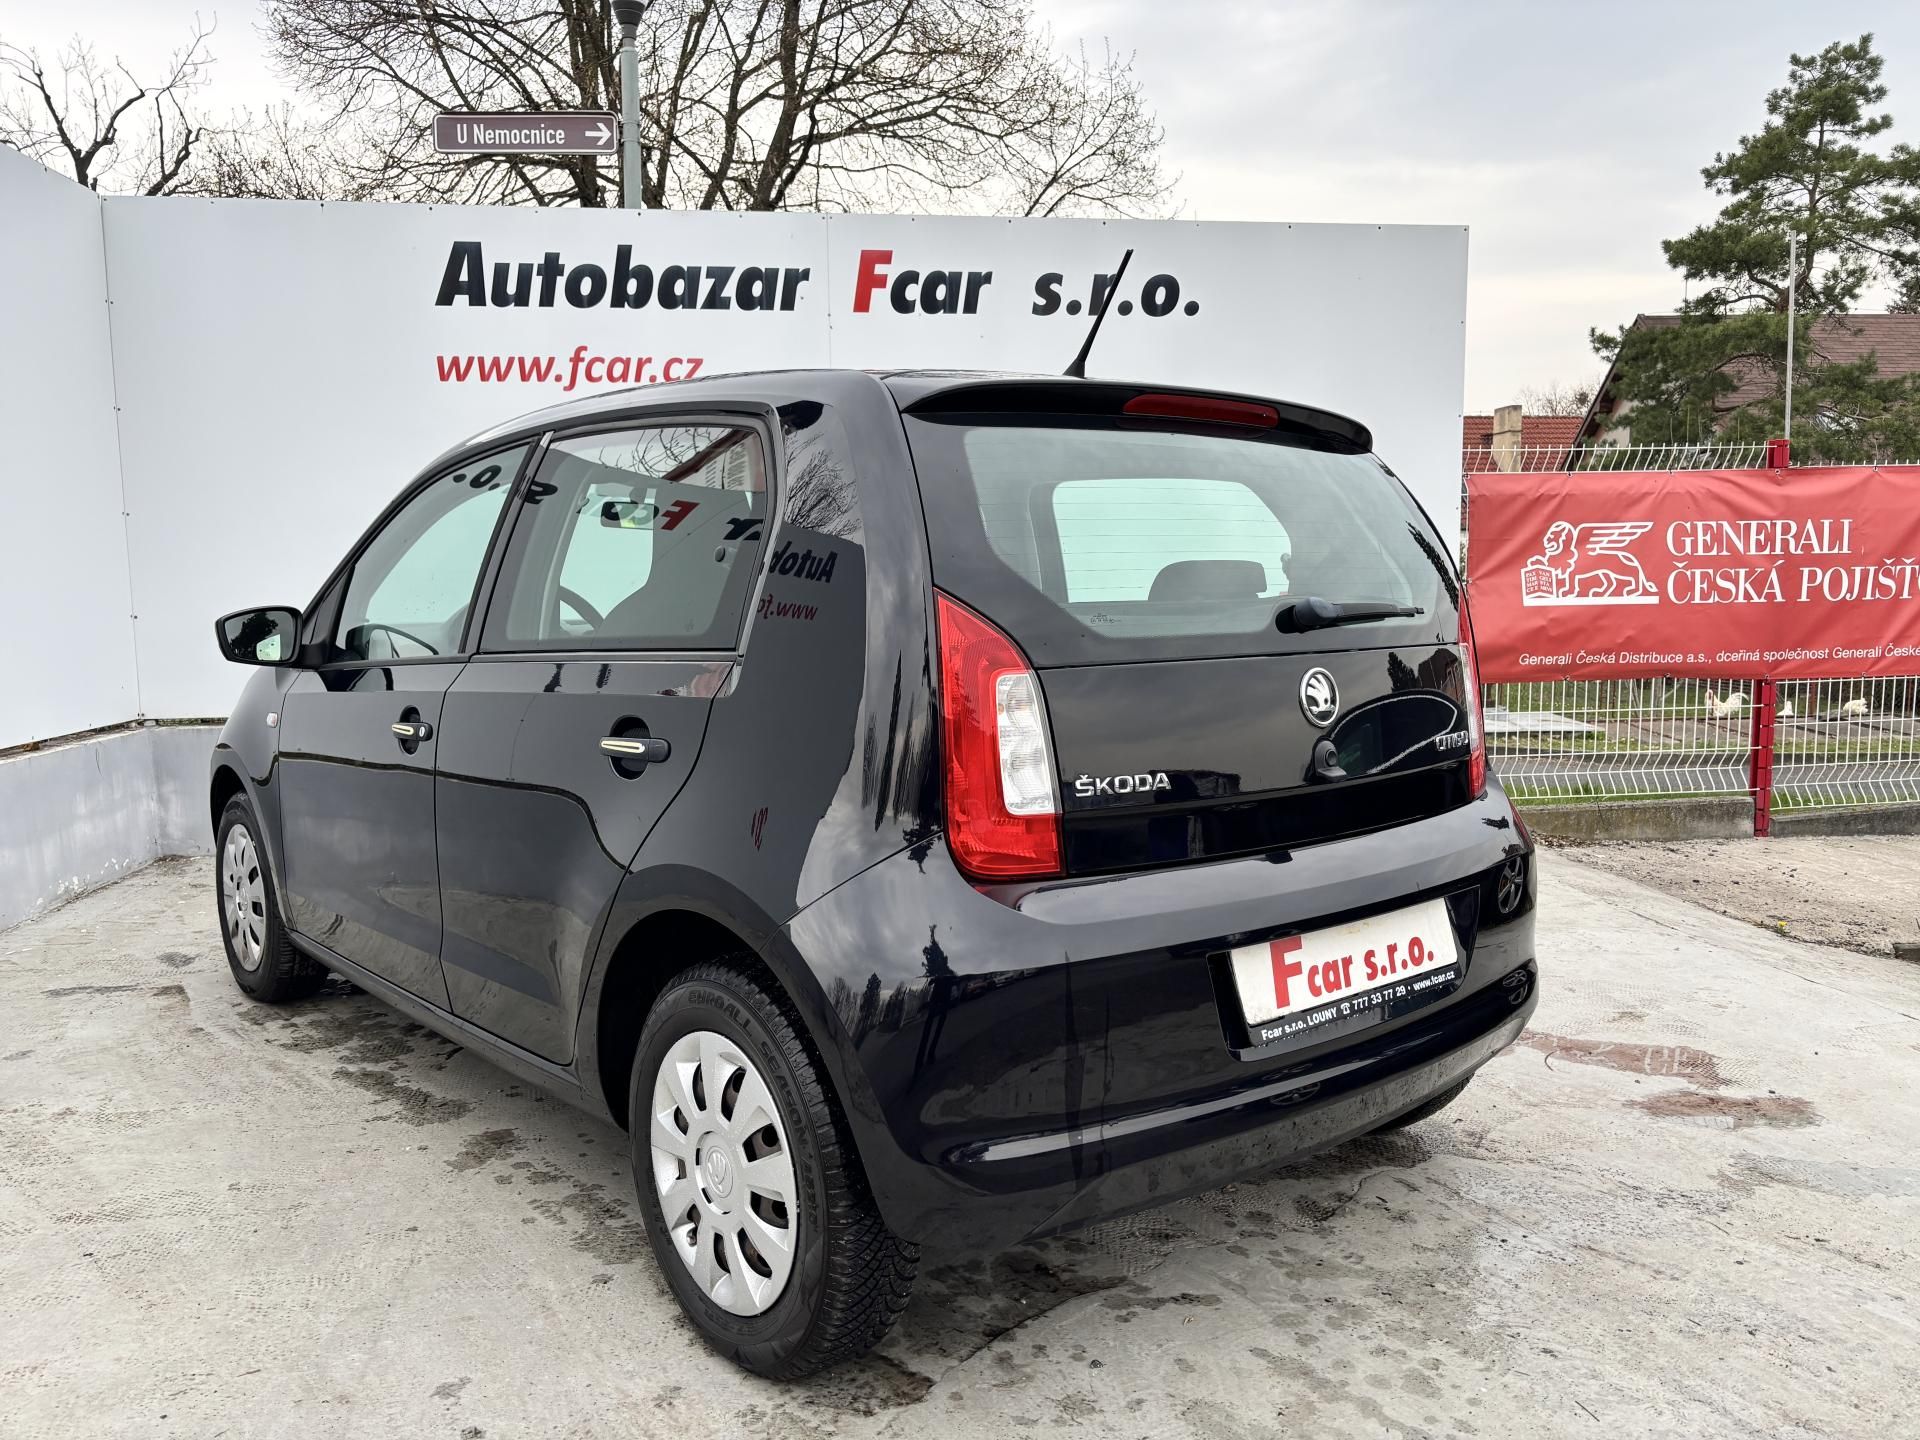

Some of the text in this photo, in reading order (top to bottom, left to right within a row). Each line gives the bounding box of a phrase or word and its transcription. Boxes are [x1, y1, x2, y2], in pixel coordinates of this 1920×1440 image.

[457, 123, 565, 145] U Nemocnice
[435, 241, 1200, 317] Autobazar Fcar s.r.o.
[436, 345, 704, 391] www.fcar.cz
[1666, 518, 1853, 557] GENERALI
[1667, 558, 1920, 604] ČESKÁ POJIŠŤ
[1519, 653, 1572, 665] Generali
[1576, 650, 1616, 664] Česká
[1619, 652, 1683, 664] Distribuce
[1687, 653, 1712, 664] a.s.,
[1716, 649, 1760, 662] dceřiná
[1763, 648, 1829, 663] společnost
[1832, 646, 1882, 659] Generali
[1075, 773, 1171, 798] ŠKODA
[1270, 935, 1434, 1009] Fcar s.r.o.
[1261, 971, 1455, 1041] Fcar s.r.o. LOUNY 777 33 77 29 www.fcar.cz
